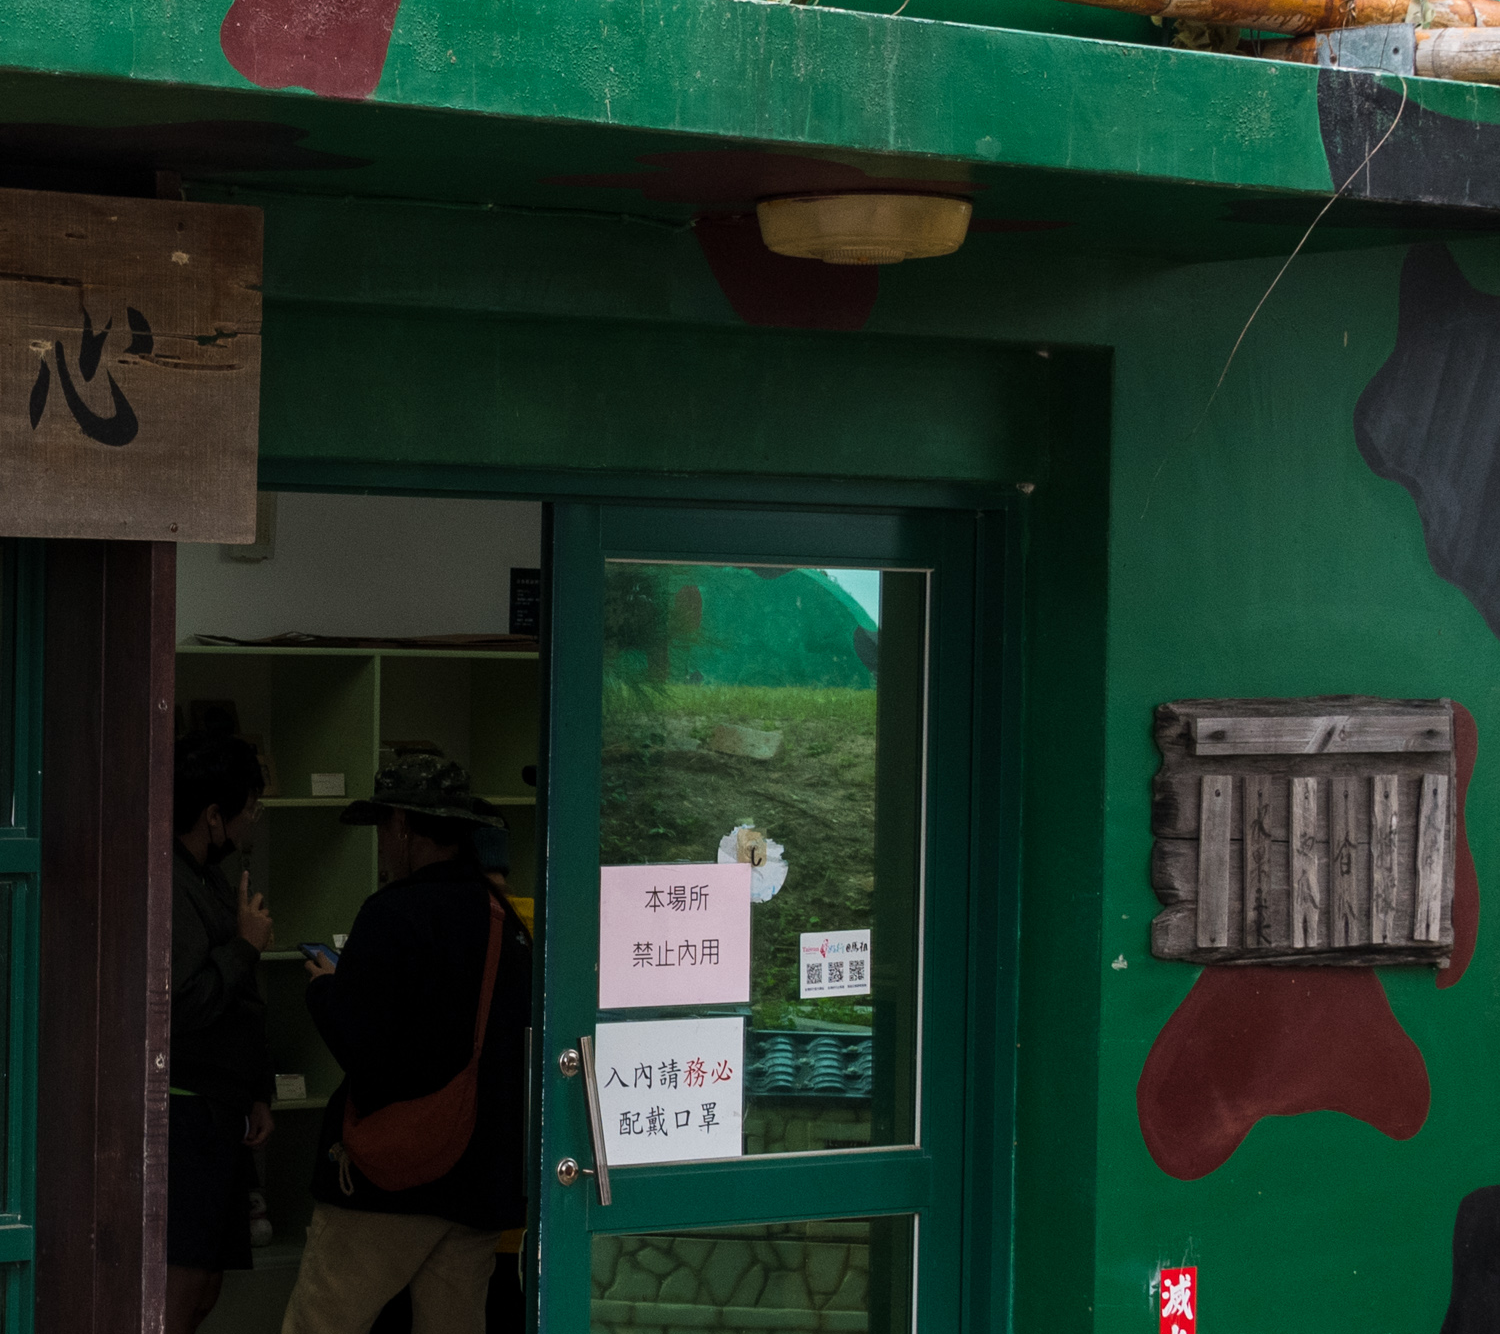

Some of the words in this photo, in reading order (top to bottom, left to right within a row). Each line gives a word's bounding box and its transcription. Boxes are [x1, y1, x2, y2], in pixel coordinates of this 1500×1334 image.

[644, 884, 710, 913] 本場所
[632, 939, 721, 968] 禁止內用
[603, 1057, 733, 1090] 入內請務必
[618, 1102, 720, 1137] 配戴口罩
